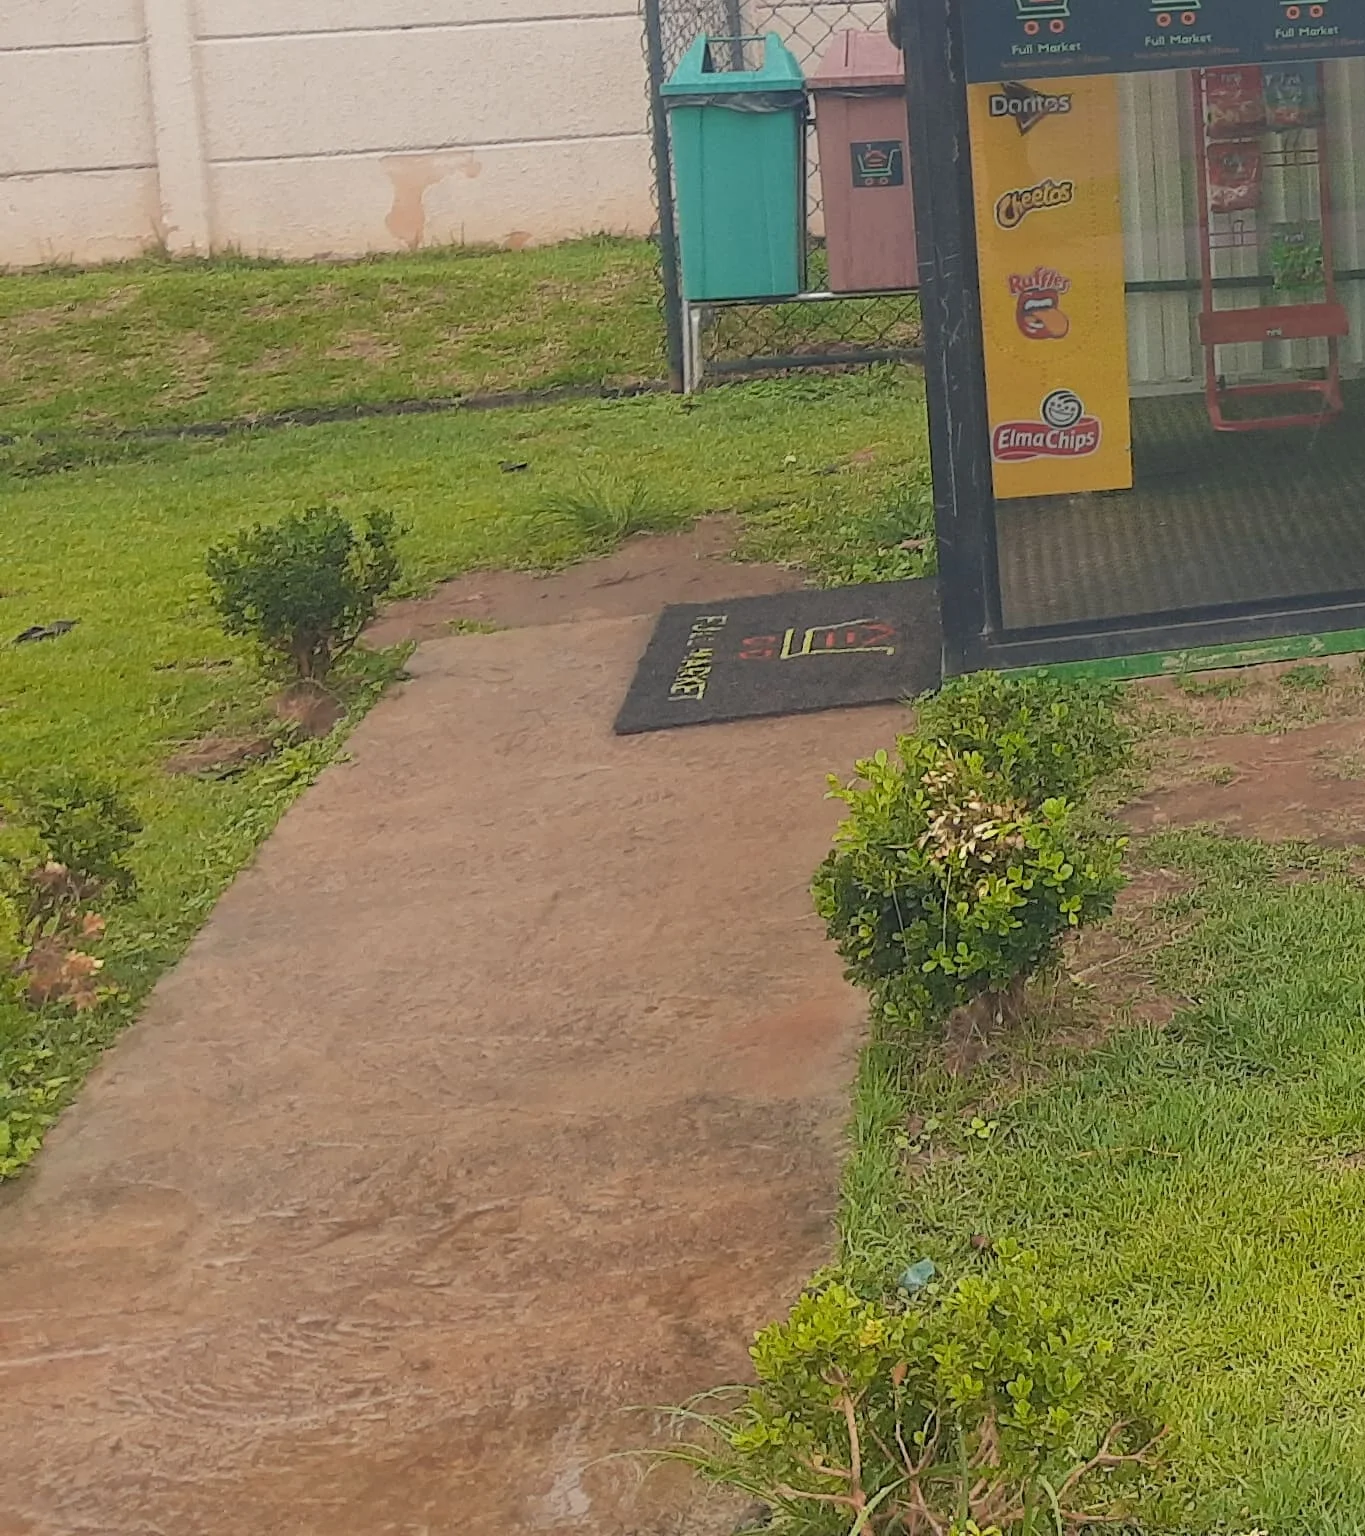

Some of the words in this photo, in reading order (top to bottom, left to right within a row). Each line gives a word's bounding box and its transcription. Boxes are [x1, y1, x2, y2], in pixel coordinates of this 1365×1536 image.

[1144, 35, 1165, 47] Full
[1169, 33, 1212, 45] Market
[1275, 27, 1295, 39] Full
[1298, 25, 1339, 37] Market
[1011, 44, 1033, 55] Full
[1037, 42, 1081, 54] Market
[990, 94, 1072, 115] Doritos
[996, 181, 1073, 228] Cheetos
[1008, 265, 1071, 295] Ruffles
